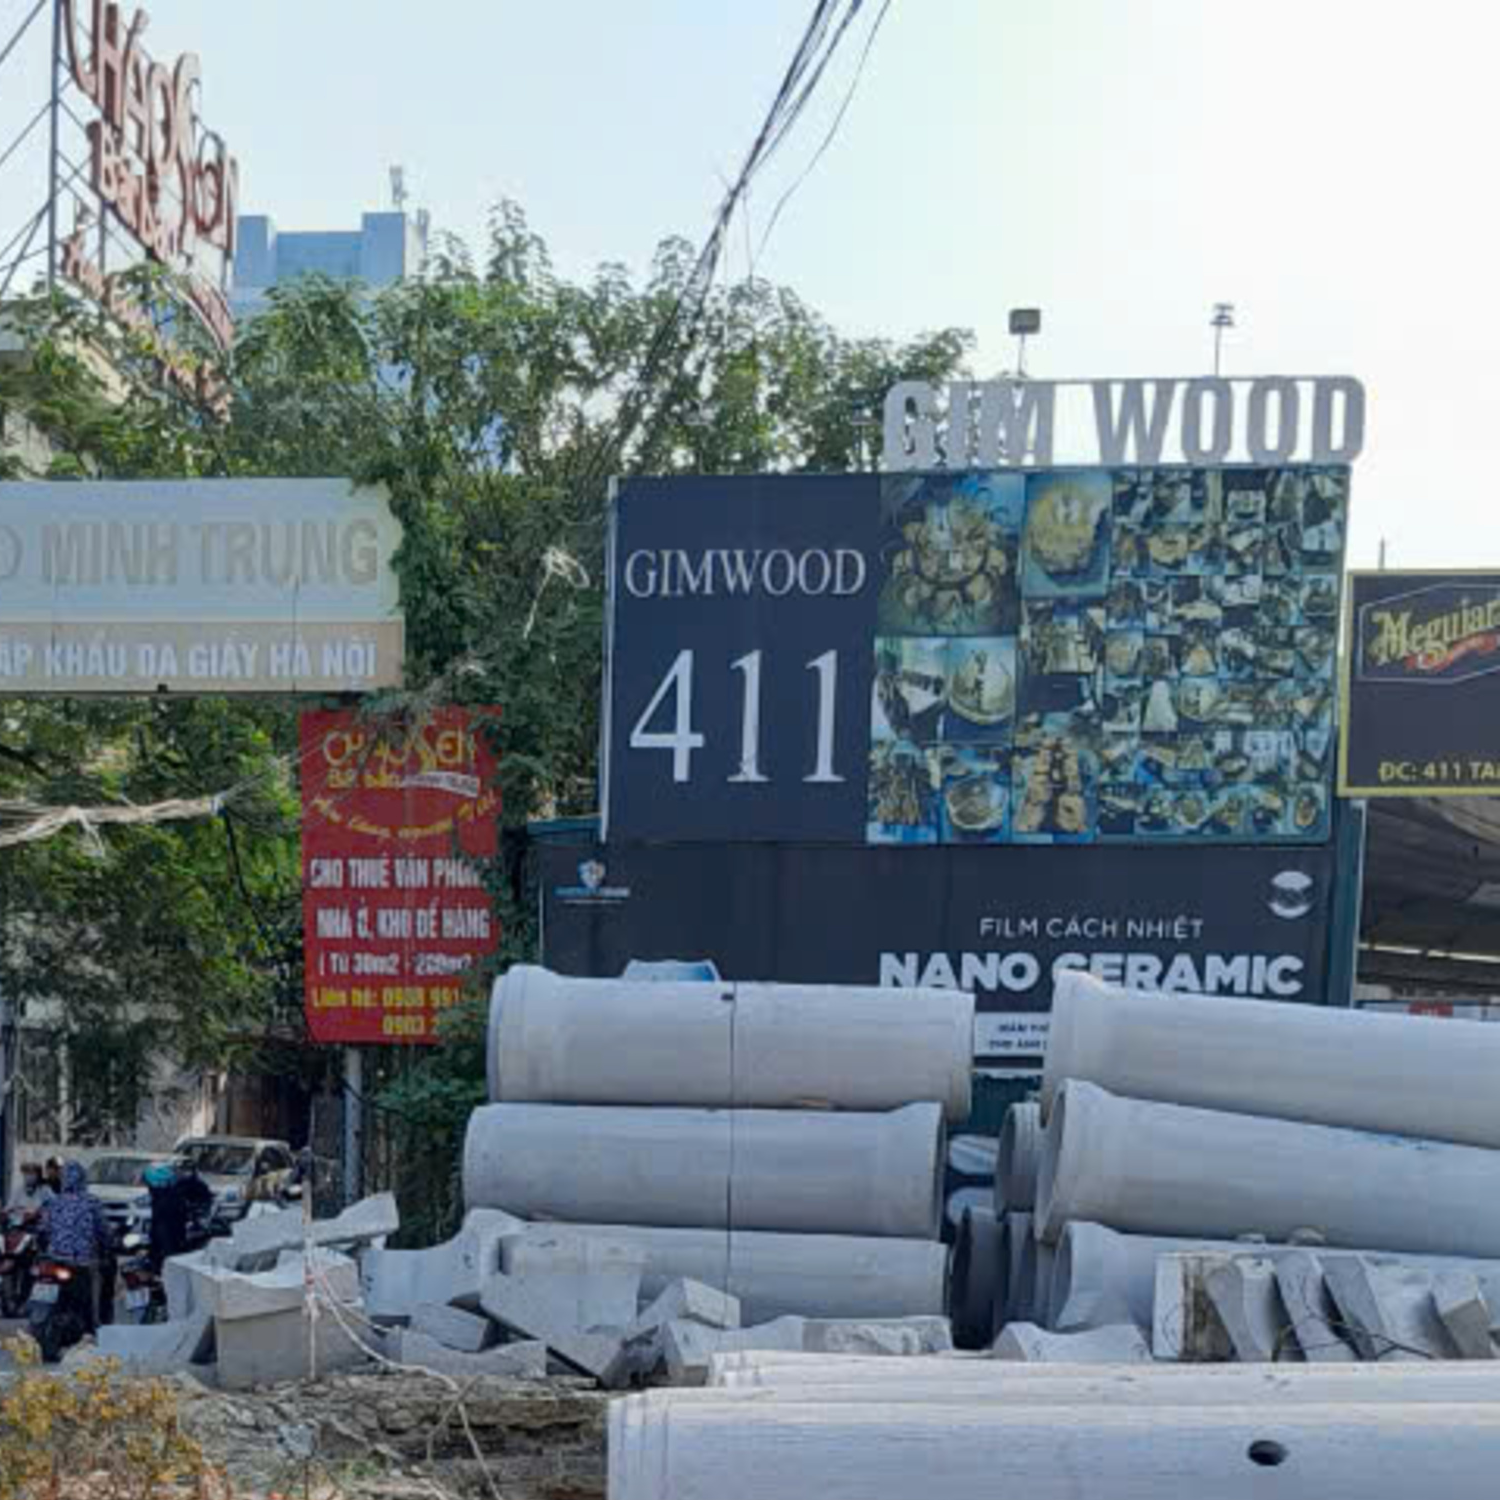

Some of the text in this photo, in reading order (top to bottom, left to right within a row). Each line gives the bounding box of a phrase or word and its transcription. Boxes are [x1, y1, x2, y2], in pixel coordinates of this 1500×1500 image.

[884, 376, 1366, 468] GIM WOOD
[40, 521, 179, 585] MINH
[191, 518, 378, 584] TRUNG
[625, 548, 867, 598] GIMWOOD
[269, 630, 310, 677] HÀ
[323, 630, 378, 686] NỘI
[629, 648, 848, 783] 411
[1422, 761, 1461, 781] 411
[1468, 761, 1500, 780] TA
[310, 858, 343, 888] CHO
[376, 909, 413, 939] KHO
[980, 911, 1204, 940] FILM CÁCH NHIỆT
[879, 952, 1303, 995] NANO CERAMIC
